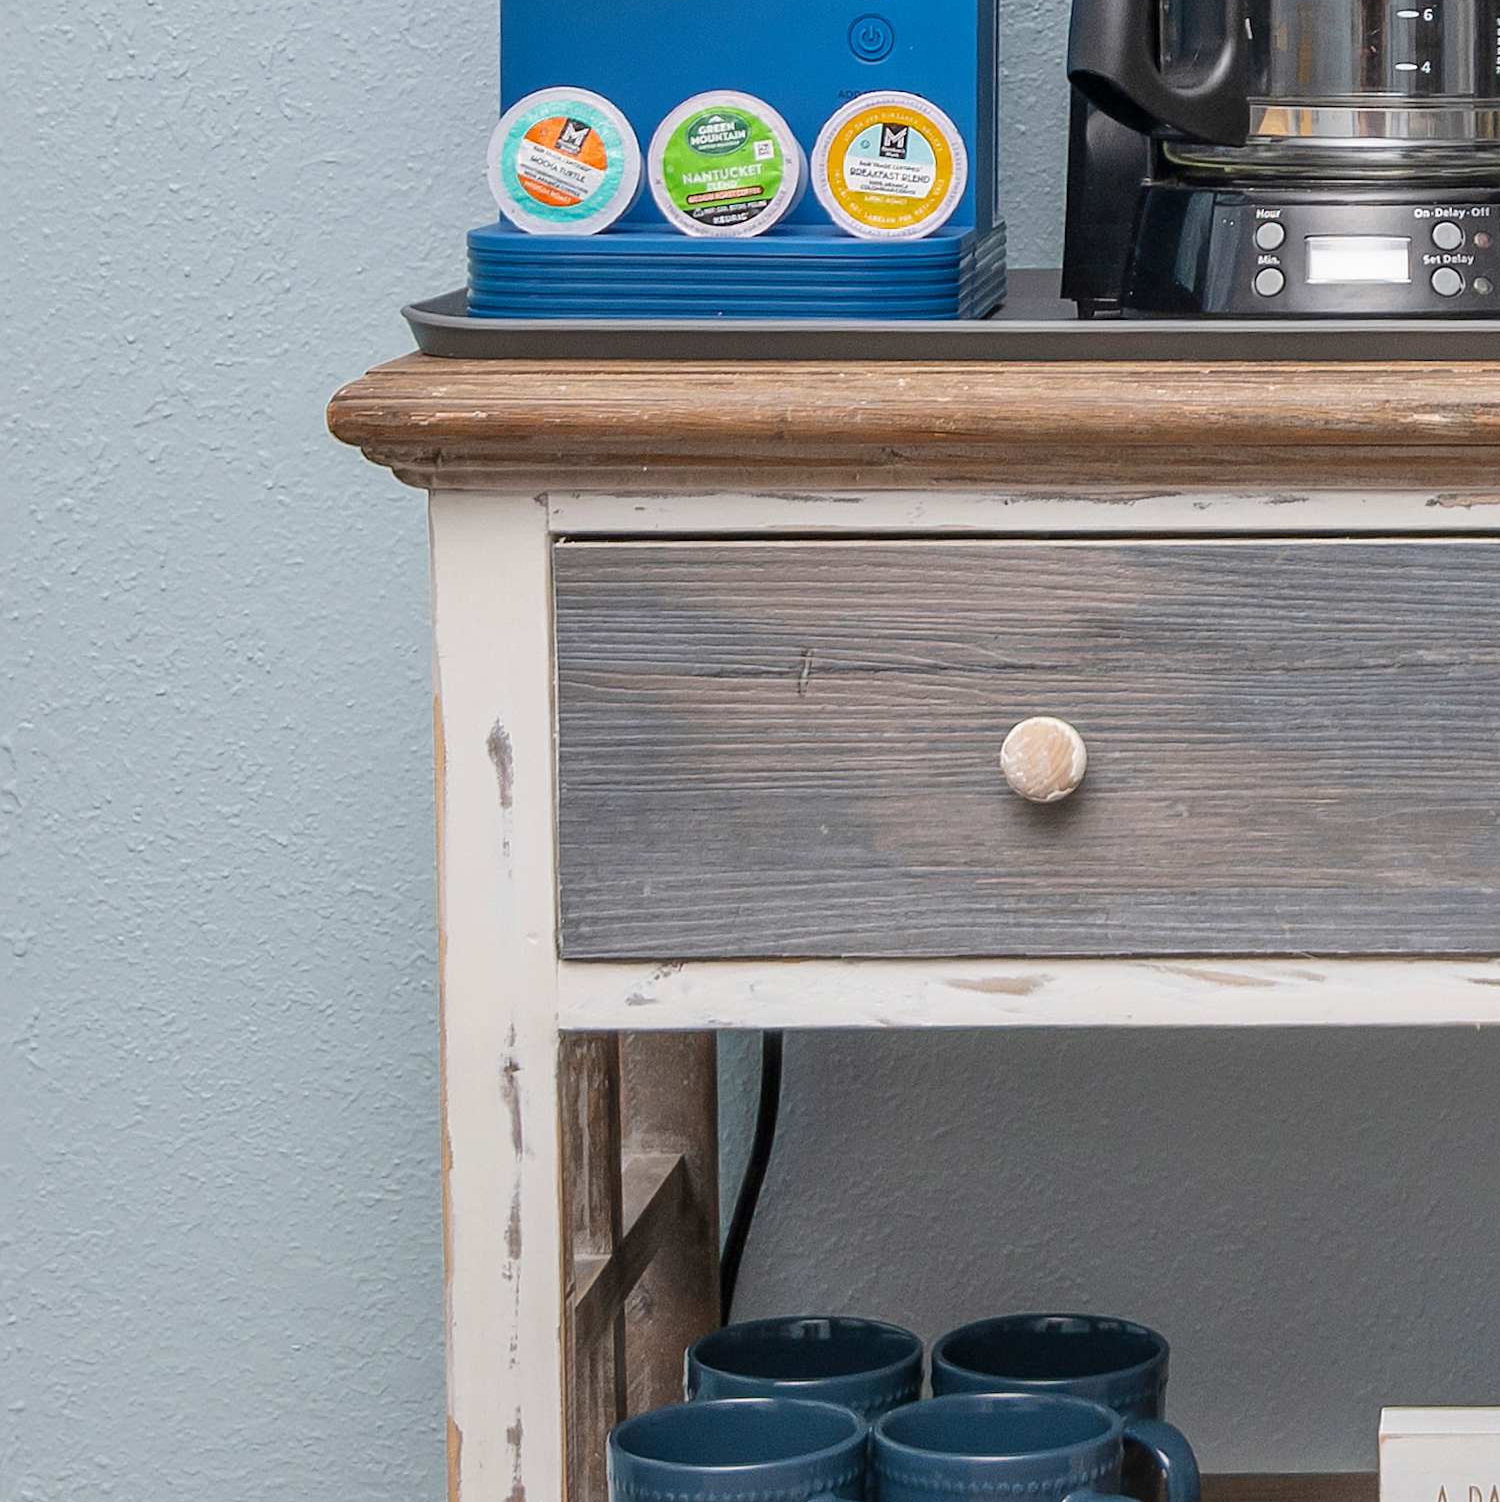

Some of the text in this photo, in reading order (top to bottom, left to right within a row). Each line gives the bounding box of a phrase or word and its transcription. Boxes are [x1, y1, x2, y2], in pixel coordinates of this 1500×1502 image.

[1423, 8, 1433, 21] 6
[1421, 61, 1431, 74] 4
[698, 122, 736, 134] GREEN
[690, 129, 747, 146] MOUNTAIN
[682, 163, 763, 184] NANTUCKET
[849, 166, 901, 181] BREAKFAST
[901, 173, 931, 184] BLEND
[1255, 208, 1281, 219] Hour
[1434, 207, 1466, 220] Delay
[1257, 254, 1281, 265] Min.
[1422, 253, 1475, 266] Set Delay
